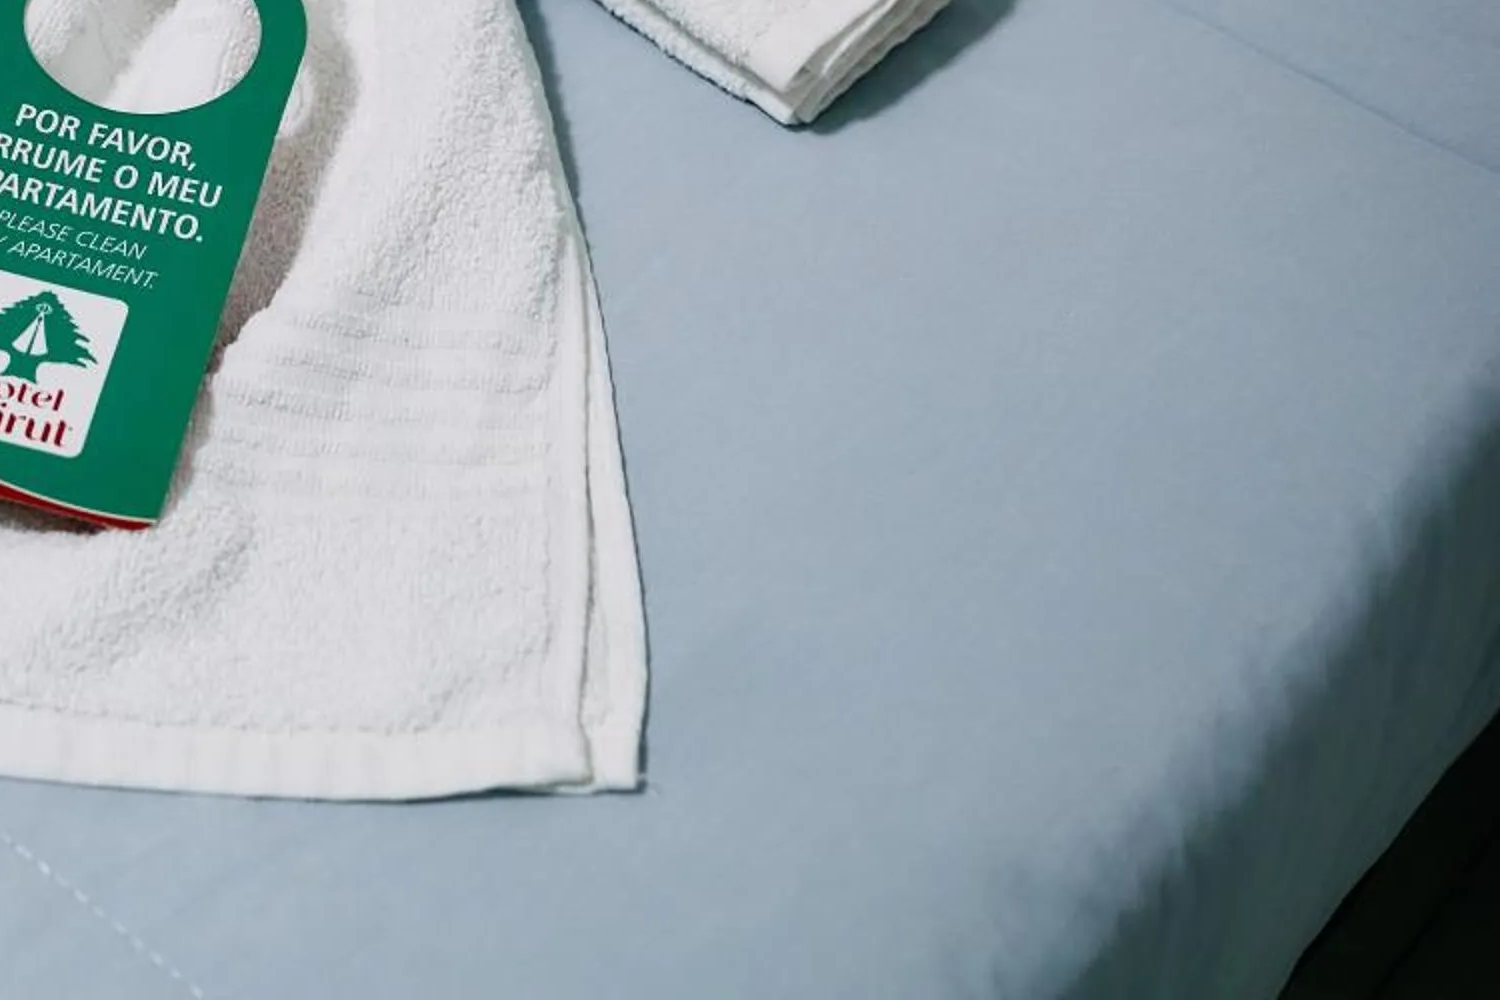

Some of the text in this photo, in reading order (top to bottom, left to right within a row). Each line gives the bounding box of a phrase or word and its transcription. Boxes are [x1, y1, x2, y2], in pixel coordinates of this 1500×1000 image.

[15, 103, 197, 171] POR FAVOR,
[113, 165, 139, 190] O
[147, 171, 223, 208] MEU
[6, 240, 160, 289] APARTAMENT.
[75, 231, 148, 260] CLEAN
